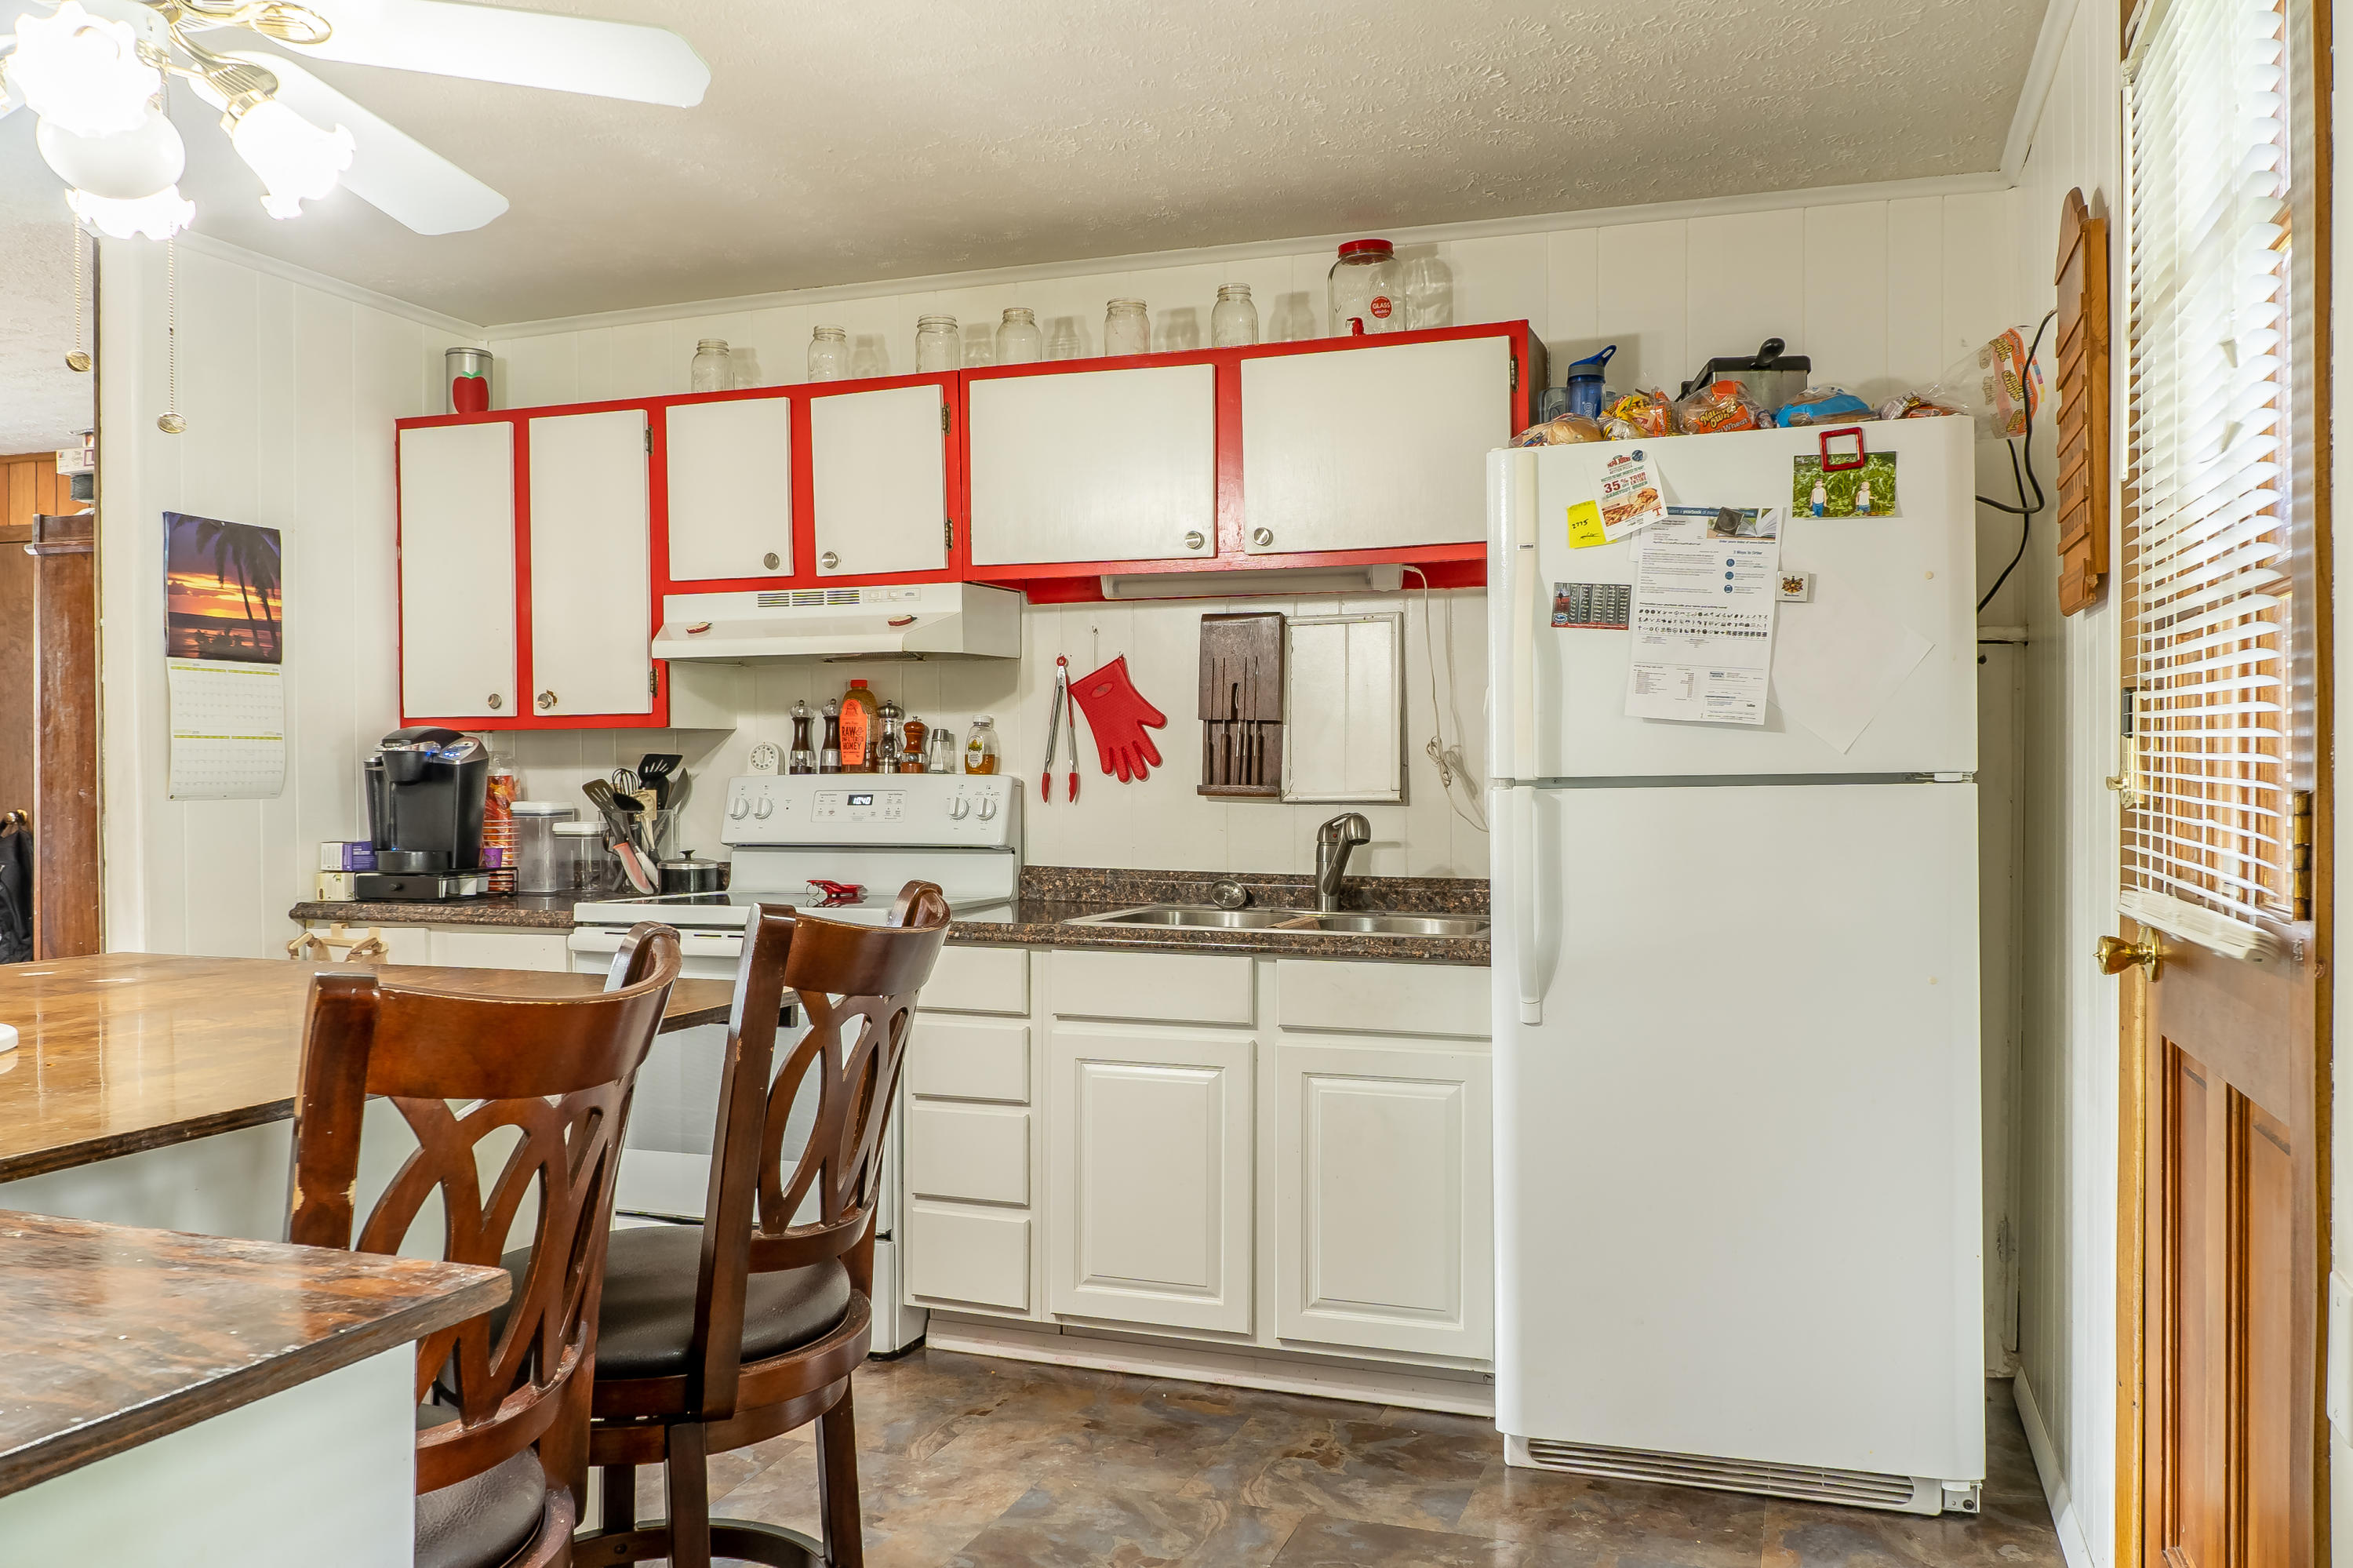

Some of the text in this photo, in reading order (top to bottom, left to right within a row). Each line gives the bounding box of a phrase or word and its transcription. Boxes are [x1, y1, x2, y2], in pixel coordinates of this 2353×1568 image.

[1630, 471, 1646, 480] YOUR
[842, 726, 856, 737] RAW
[842, 741, 861, 750] HONEY
